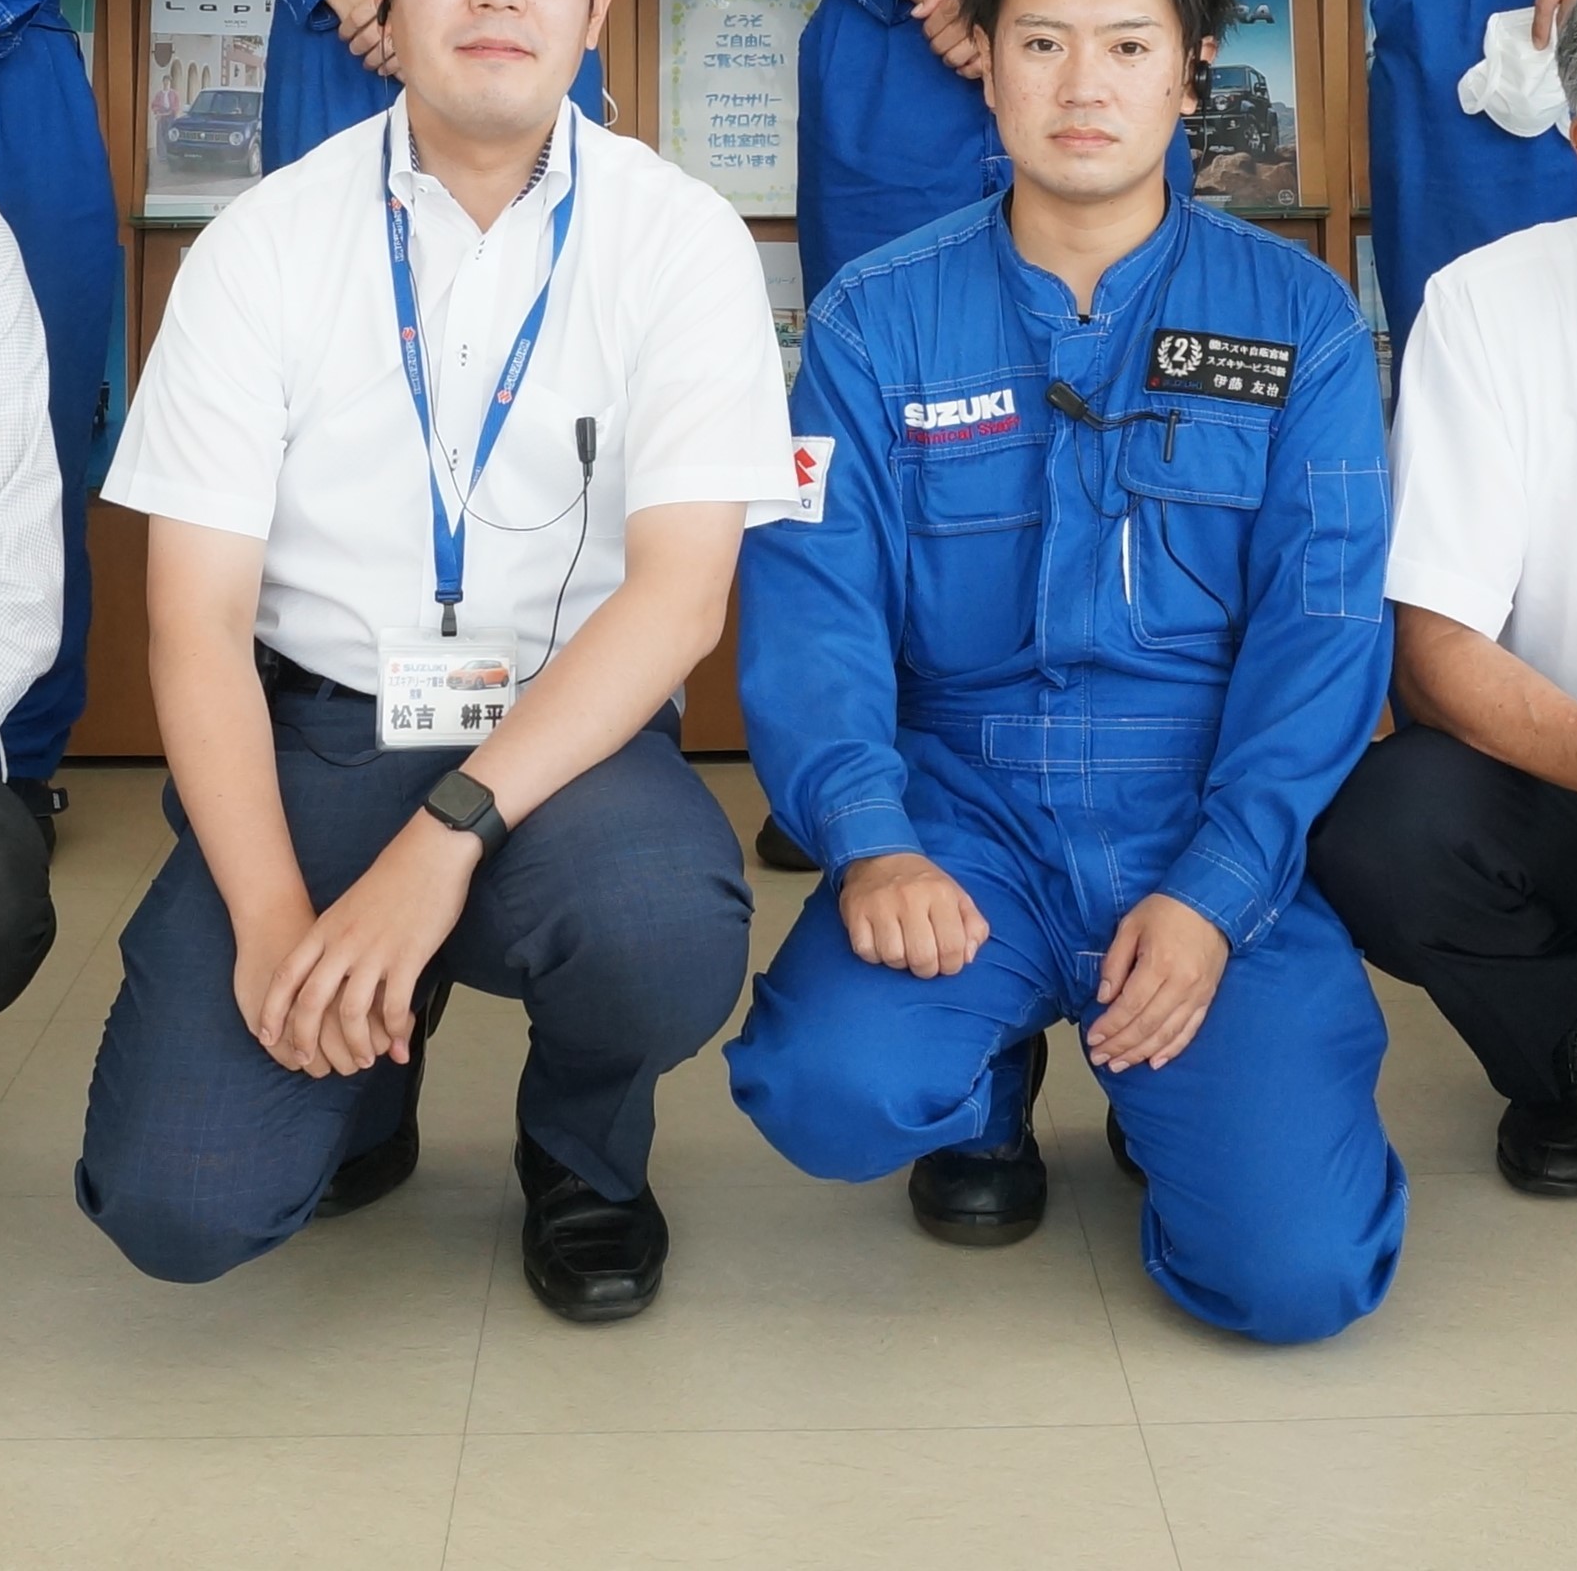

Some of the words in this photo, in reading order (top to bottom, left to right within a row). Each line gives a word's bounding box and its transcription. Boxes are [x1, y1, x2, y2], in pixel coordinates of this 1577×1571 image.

[715, 34, 772, 49] ご自由に
[703, 53, 785, 69] ご覧ください
[705, 93, 782, 109] アクセサリー
[710, 113, 778, 128] カタログは
[708, 133, 780, 148] 化粧室前に
[710, 153, 778, 168] ございます
[1172, 337, 1189, 362] 2
[904, 388, 1016, 430] SUZUKI
[390, 704, 436, 730] 松吉
[460, 703, 505, 730] 耕平
